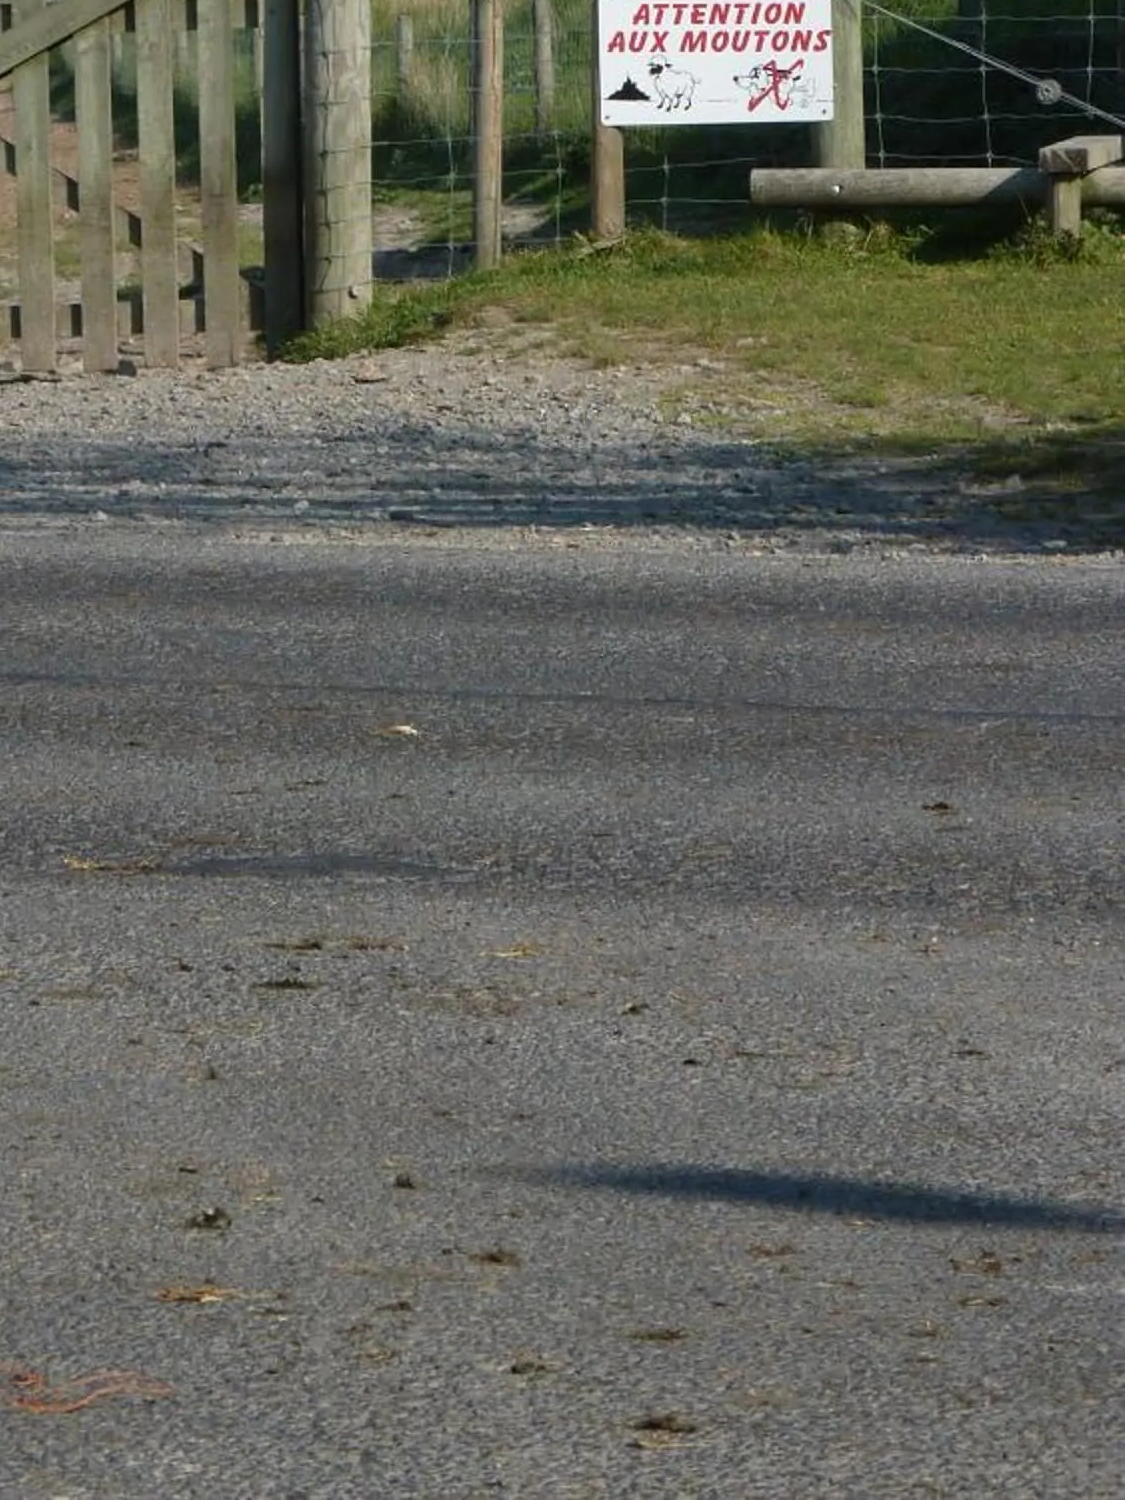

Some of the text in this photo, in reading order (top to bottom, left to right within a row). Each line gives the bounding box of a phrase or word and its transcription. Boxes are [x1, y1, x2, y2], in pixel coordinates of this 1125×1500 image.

[633, 2, 806, 25] ATTENTION
[607, 30, 832, 53] AUX MOUTONS
